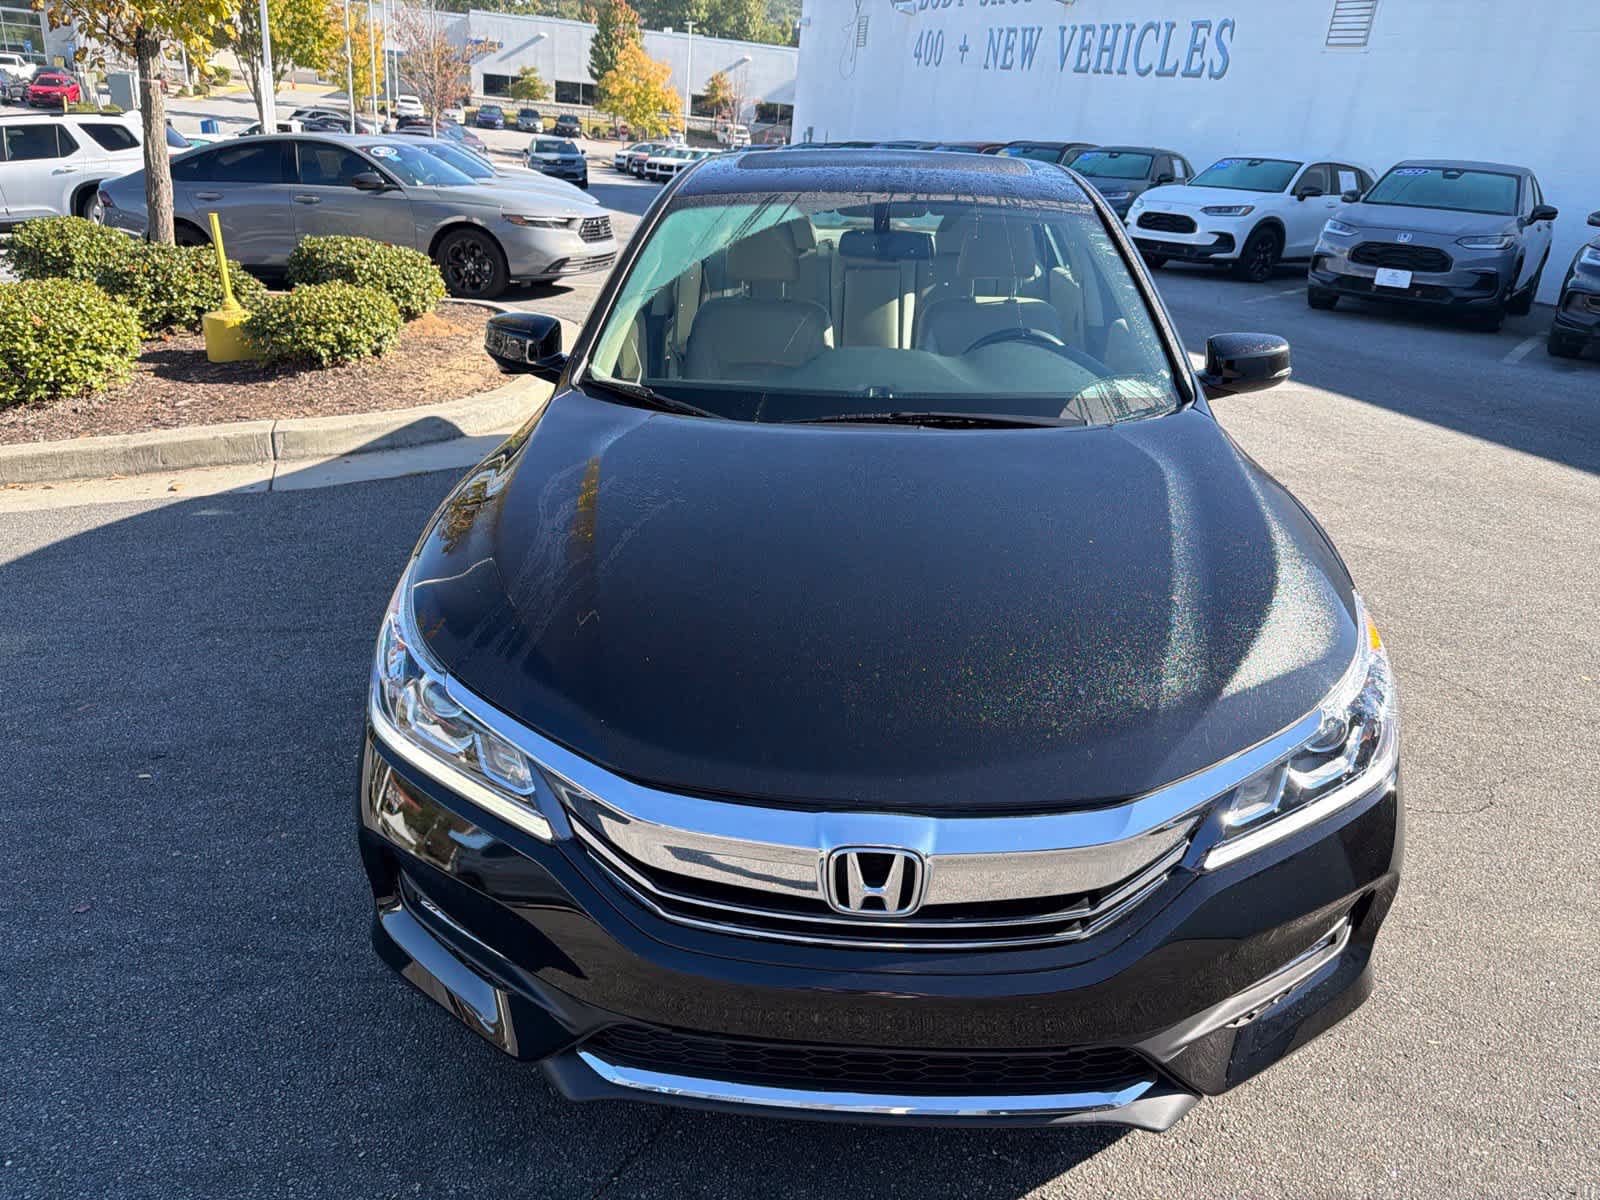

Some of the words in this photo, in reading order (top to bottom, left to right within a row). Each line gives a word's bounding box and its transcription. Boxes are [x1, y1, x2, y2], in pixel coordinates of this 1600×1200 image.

[913, 29, 944, 67] 400
[959, 33, 969, 64] +
[983, 26, 1043, 71] NEW
[1058, 18, 1236, 80] VEHICLES
